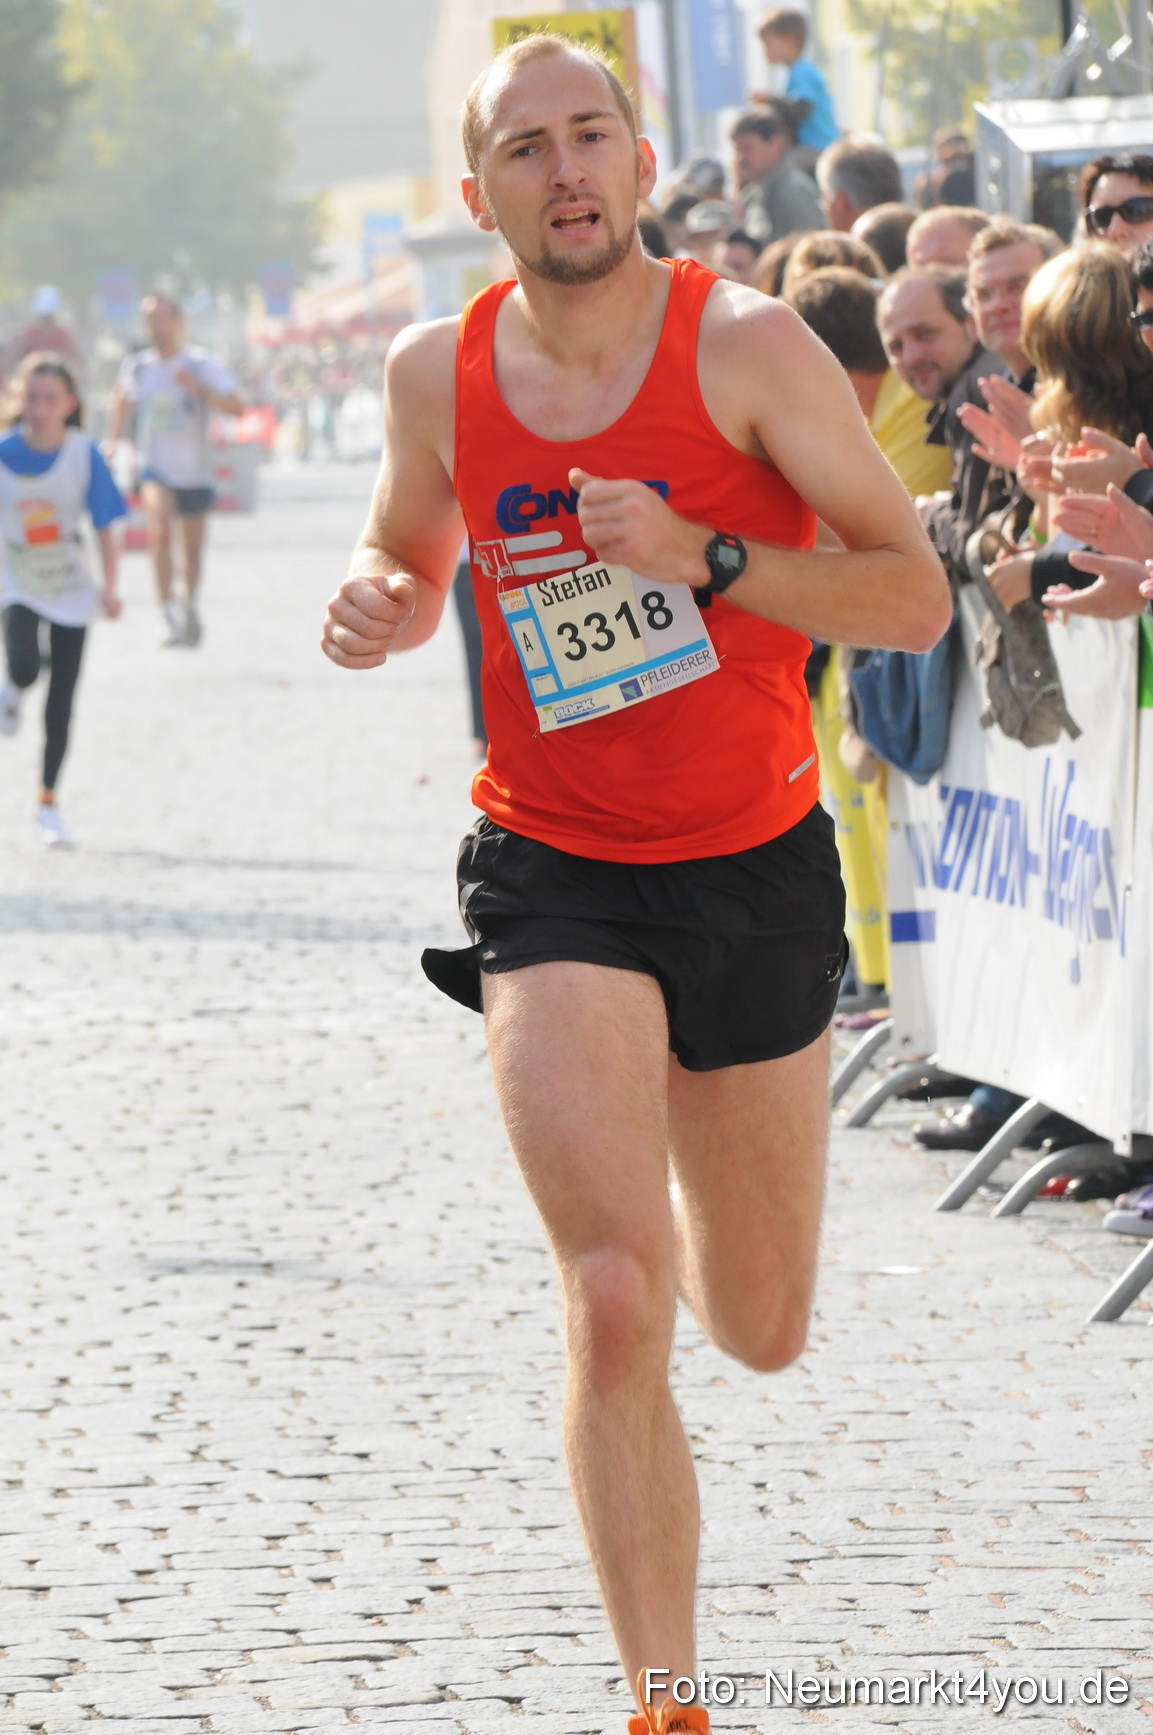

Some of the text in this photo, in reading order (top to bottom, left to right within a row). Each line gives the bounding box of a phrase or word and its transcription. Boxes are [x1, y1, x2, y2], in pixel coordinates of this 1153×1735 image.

[536, 568, 612, 607] Stefan
[523, 632, 534, 652] A
[557, 591, 673, 661] 3318
[640, 649, 712, 687] PFLEIDERER
[554, 697, 595, 719] BOCK
